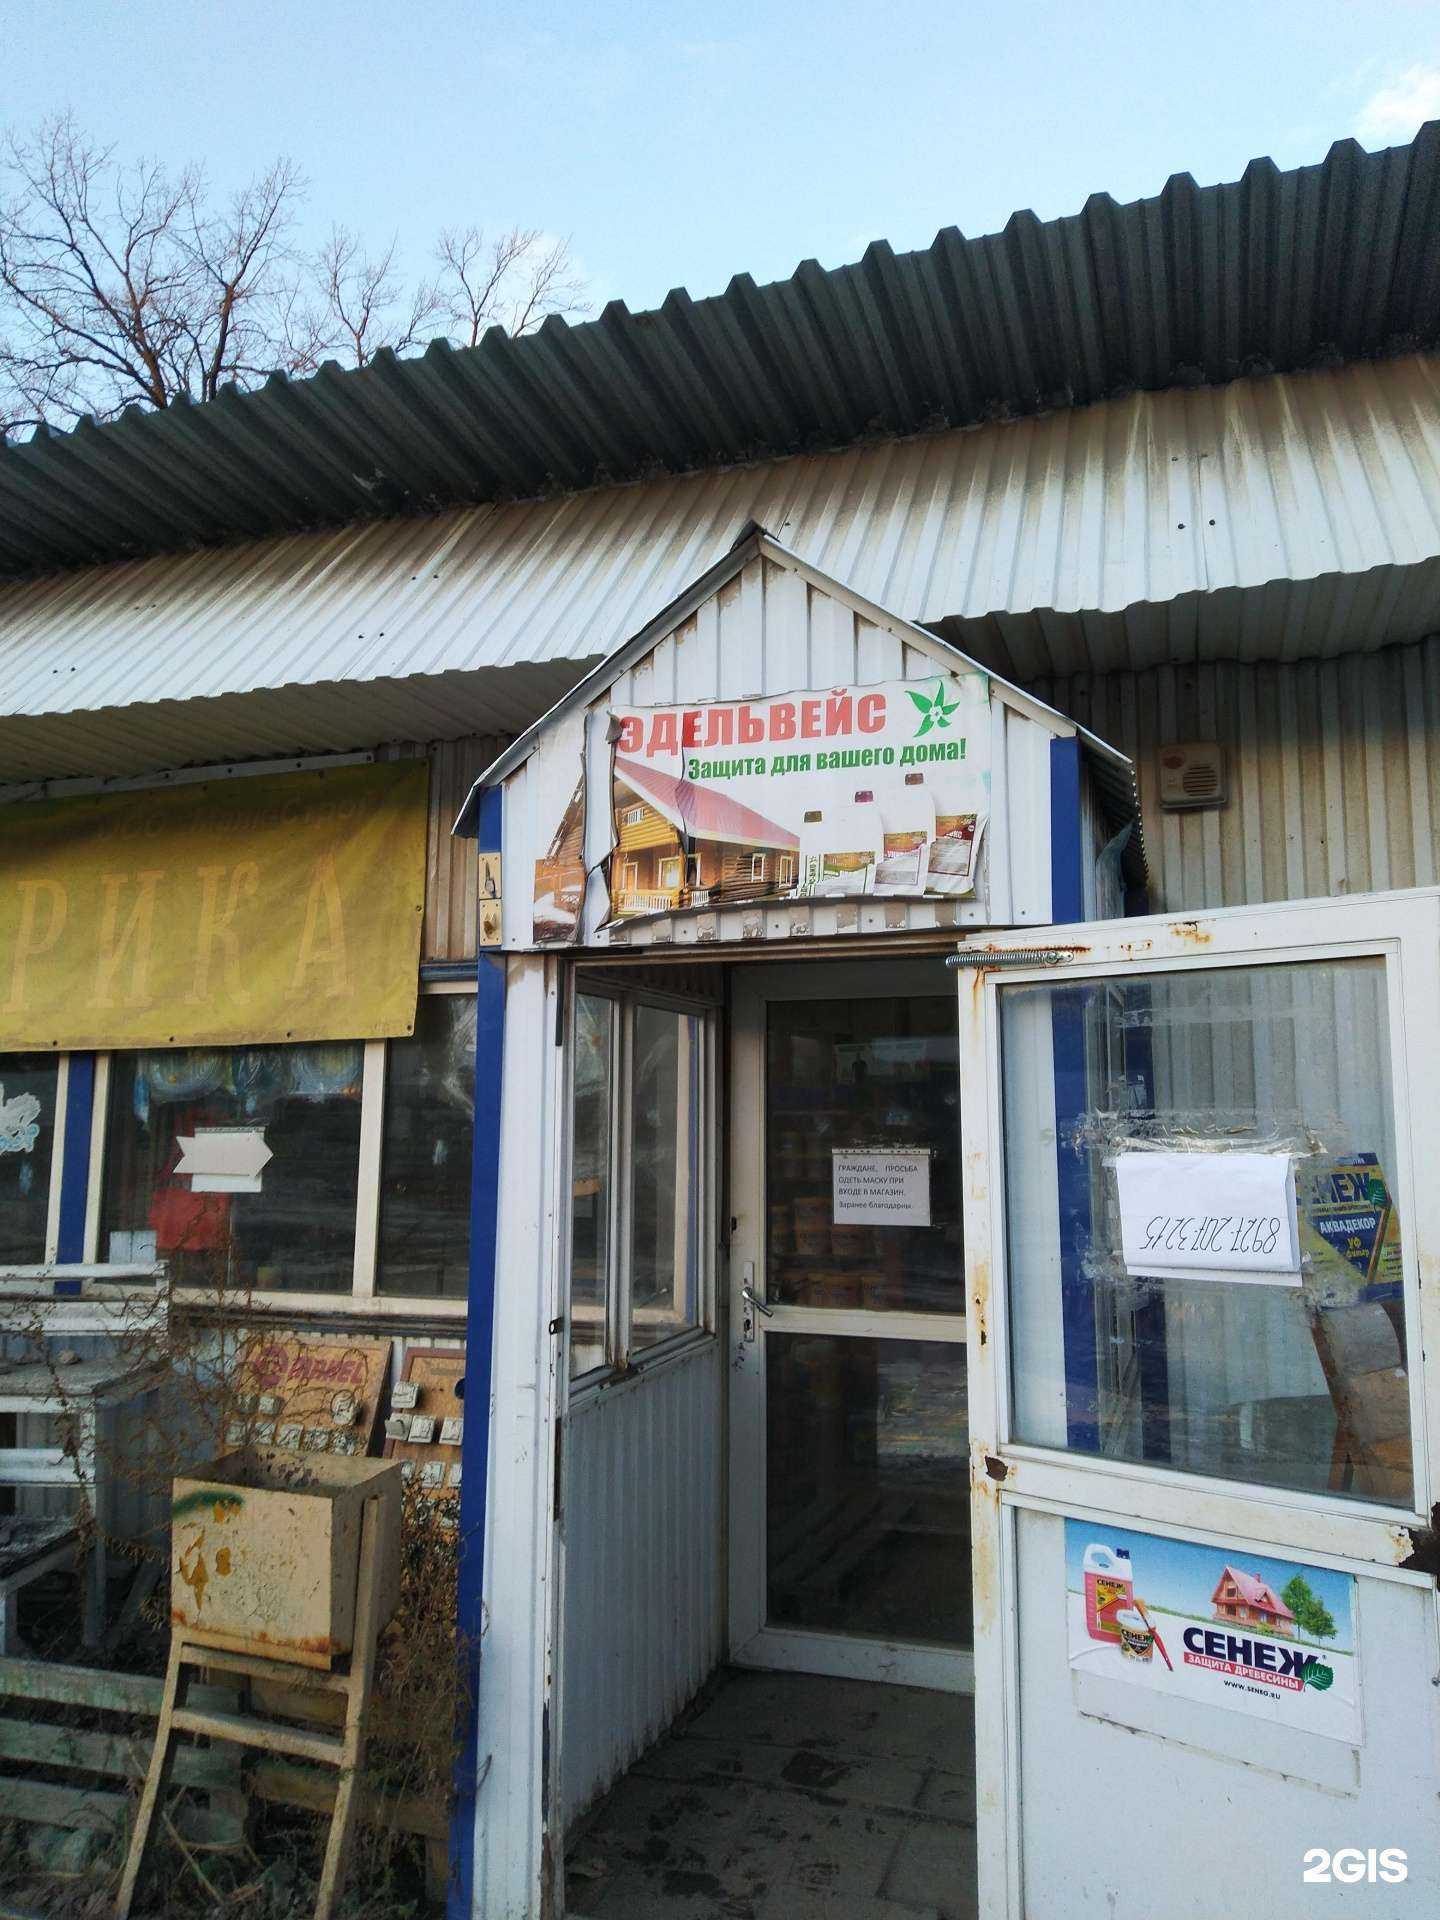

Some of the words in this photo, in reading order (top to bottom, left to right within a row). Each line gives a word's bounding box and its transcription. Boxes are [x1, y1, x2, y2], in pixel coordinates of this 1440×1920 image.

[618, 688, 886, 758] ЭДЕЛЬВЕЙС
[688, 754, 766, 780] Защита
[770, 753, 811, 776] для
[816, 746, 894, 770] вашего
[899, 738, 967, 767] дома!
[885, 1165, 918, 1173] ПРОСЬБА
[838, 1201, 867, 1210] Заранее
[1320, 1218, 1376, 1234] АКВАДЕКОР
[1183, 1627, 1319, 1678] СЕНЕЖ
[1188, 1654, 1232, 1672] ЗАЩИТА
[1234, 1663, 1299, 1689] ДРЕВЕСИНЫ
